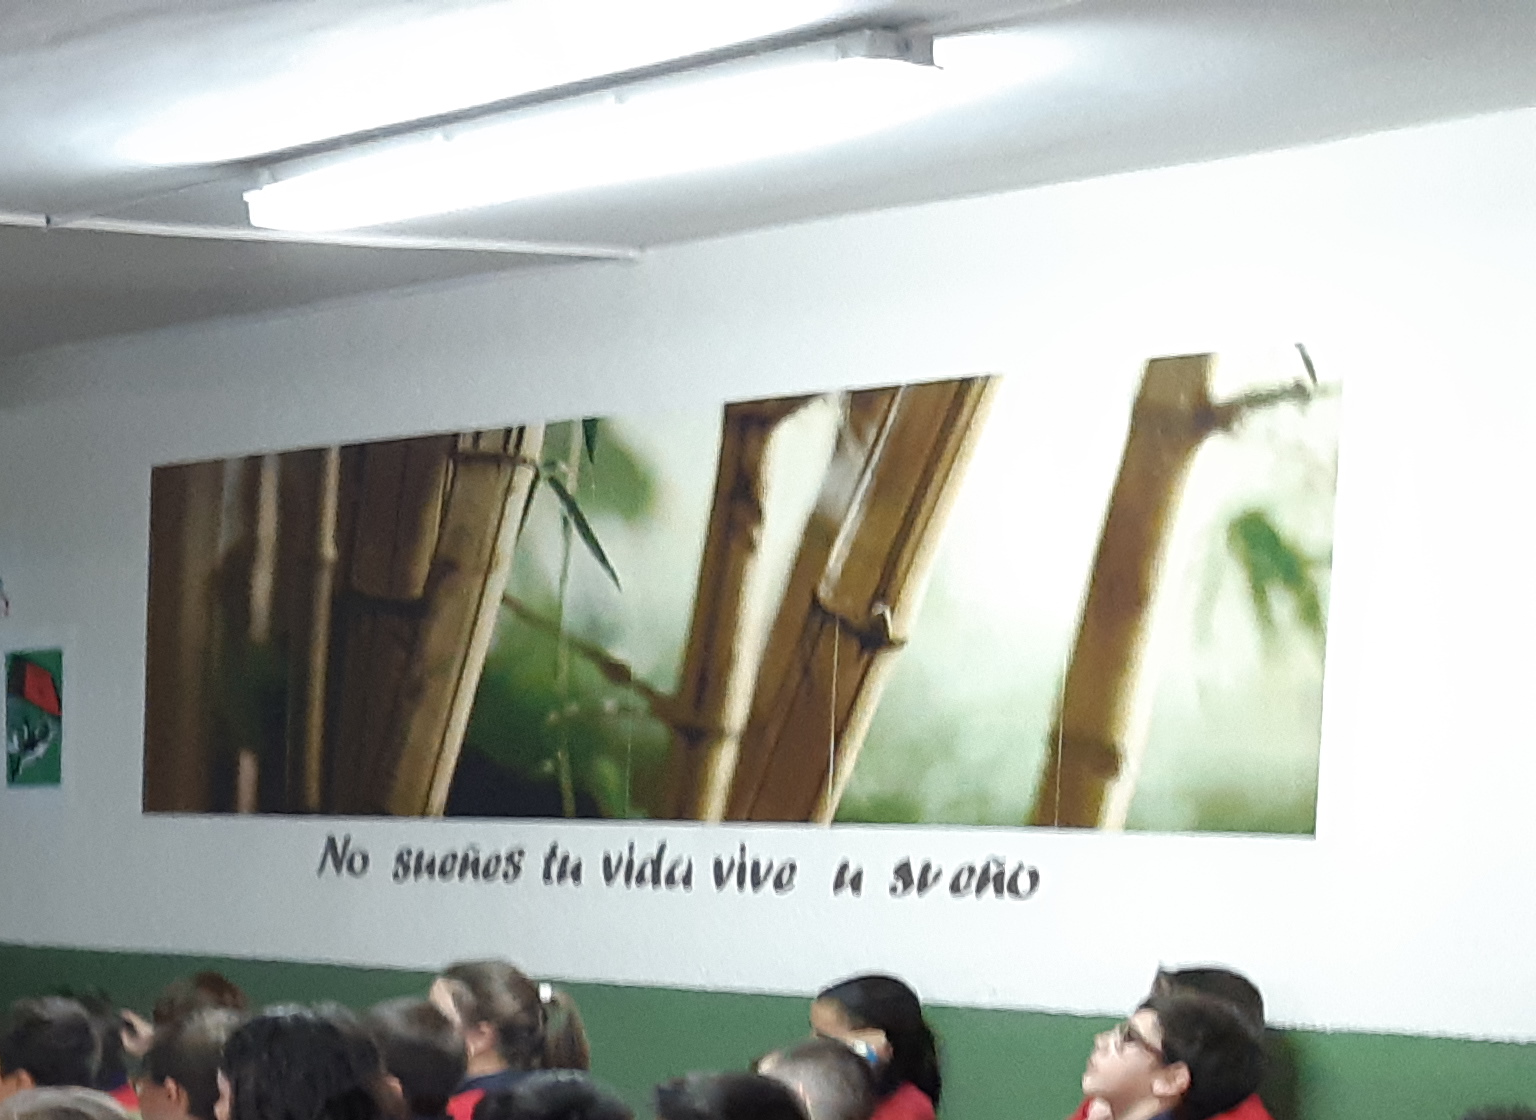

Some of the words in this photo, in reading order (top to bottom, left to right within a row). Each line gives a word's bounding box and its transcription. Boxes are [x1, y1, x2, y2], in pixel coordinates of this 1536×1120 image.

[316, 833, 370, 879] No
[541, 840, 583, 886] tu
[602, 839, 693, 890] vida
